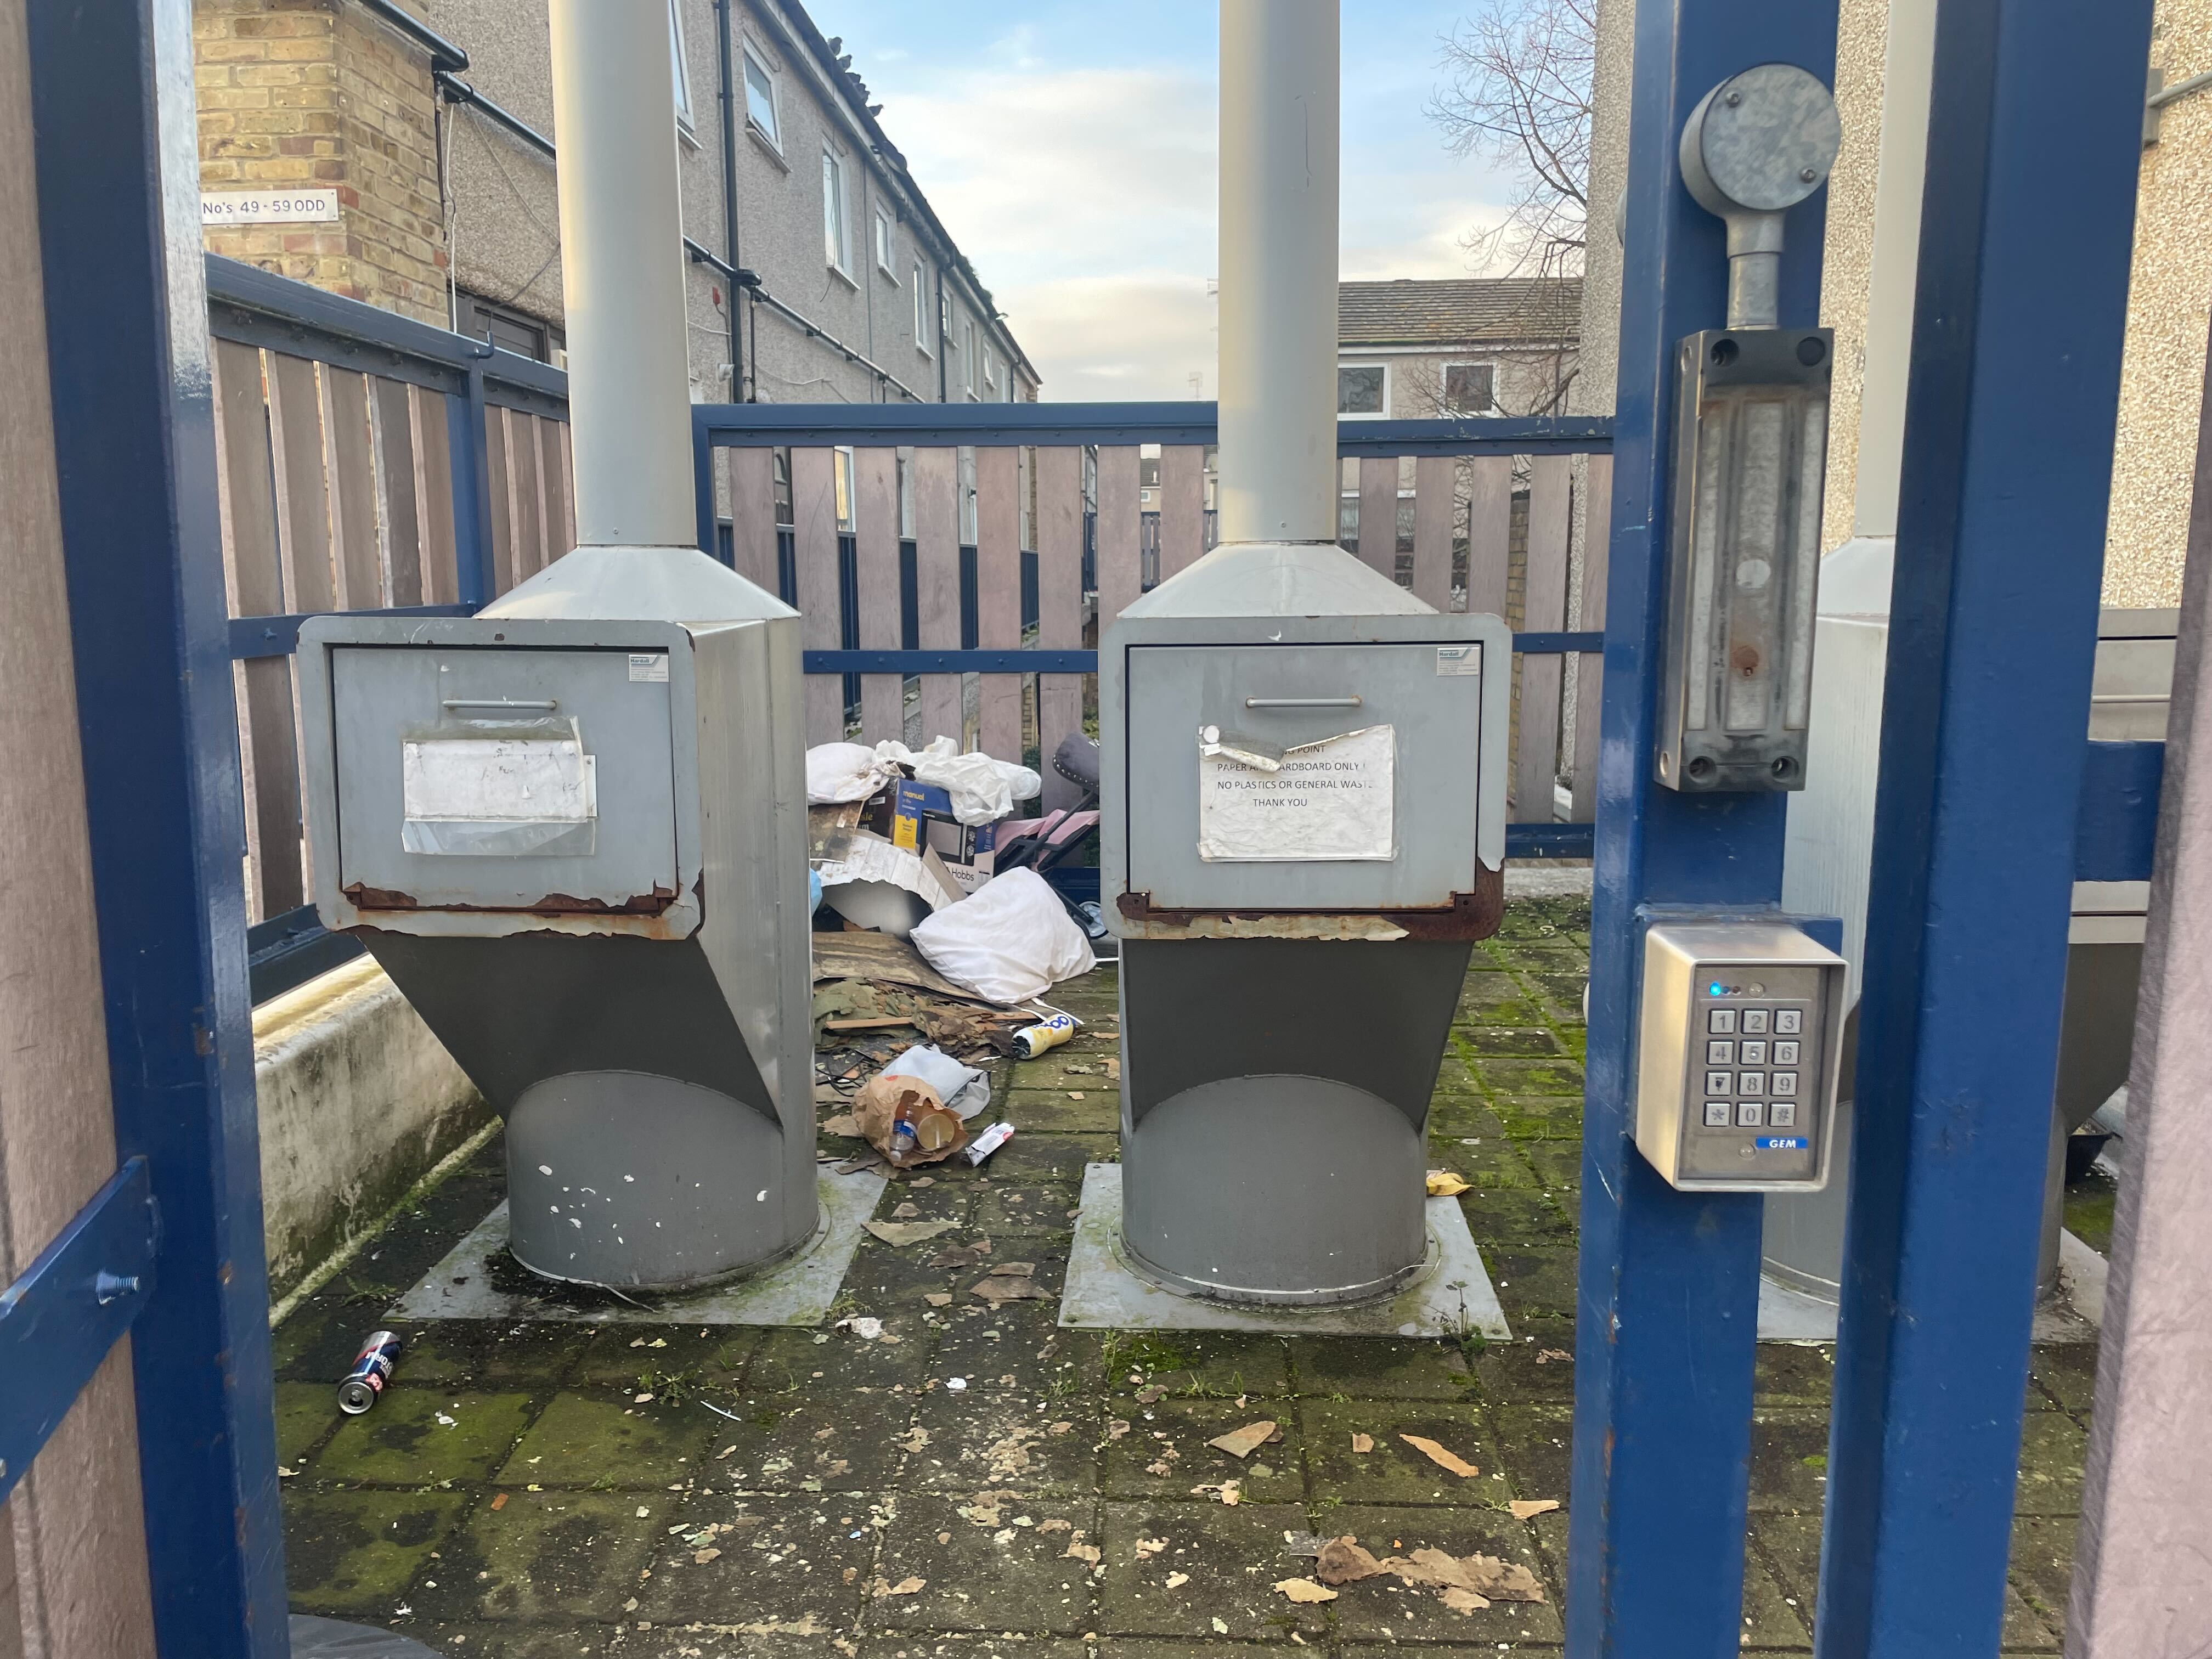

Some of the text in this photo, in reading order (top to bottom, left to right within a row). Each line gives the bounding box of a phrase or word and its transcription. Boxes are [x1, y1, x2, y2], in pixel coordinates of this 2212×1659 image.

[202, 202, 233, 213] No's
[240, 201, 259, 212] 49
[273, 200, 290, 212] 59
[295, 199, 325, 211] ODD
[1297, 744, 1325, 754] POINT
[1217, 763, 1246, 771] PAPER
[1276, 763, 1331, 771] ARDBOARD
[1334, 763, 1359, 771] ONLY
[1217, 781, 1232, 789] NO
[1235, 781, 1276, 789] PLASTICS
[1279, 781, 1292, 789] OR
[1253, 798, 1307, 807] THANK YOU
[952, 867, 974, 882] Hobbs
[1719, 1015, 1794, 1029] 1 2 3
[1716, 1046, 1792, 1060] 4 5 6
[1747, 1076, 1757, 1091] 8
[1779, 1077, 1790, 1091] 9
[1745, 1108, 1756, 1122] 0
[1769, 1139, 1796, 1148] GEM
